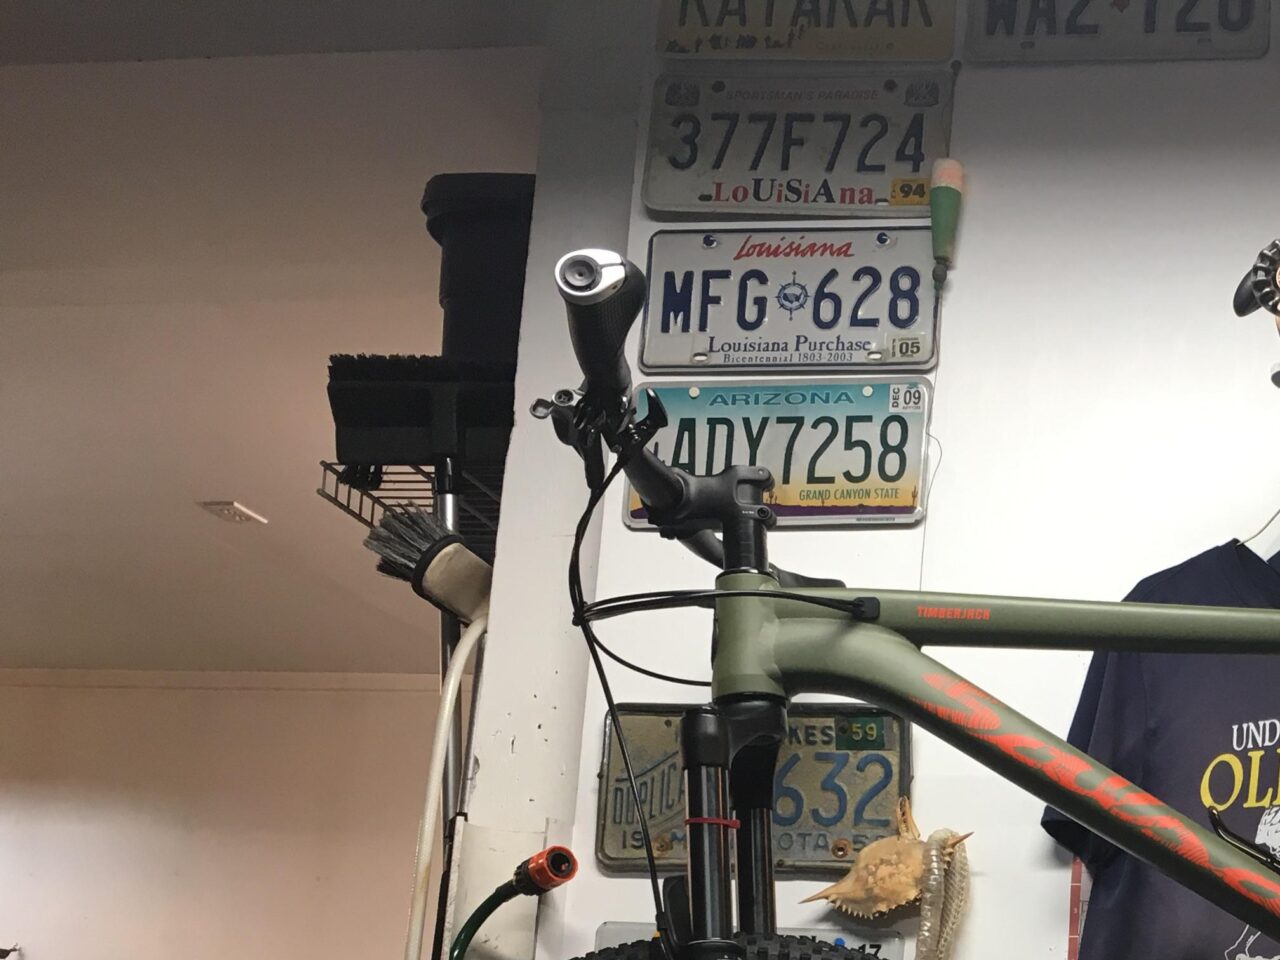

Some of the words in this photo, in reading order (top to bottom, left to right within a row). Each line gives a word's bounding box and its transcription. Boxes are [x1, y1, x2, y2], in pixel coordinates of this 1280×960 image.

[667, 111, 926, 173] 377F724
[899, 181, 927, 200] 94
[731, 234, 856, 262] Louisiana
[660, 267, 770, 334] MFG
[811, 264, 923, 331] 628
[707, 335, 790, 355] Louisiana
[794, 333, 873, 352] Purchase
[898, 341, 921, 356] 05
[722, 352, 793, 365] Bicentennial
[708, 390, 857, 408] ARIZONA
[891, 387, 901, 408] DEC
[903, 389, 922, 406] 09
[670, 414, 911, 488] ADY7258
[798, 489, 832, 501] GRAND
[834, 488, 872, 501] CANYON
[874, 487, 900, 500] STATE
[916, 605, 991, 621] TIMBERJACK
[850, 722, 878, 741] 59
[772, 751, 894, 827] 632
